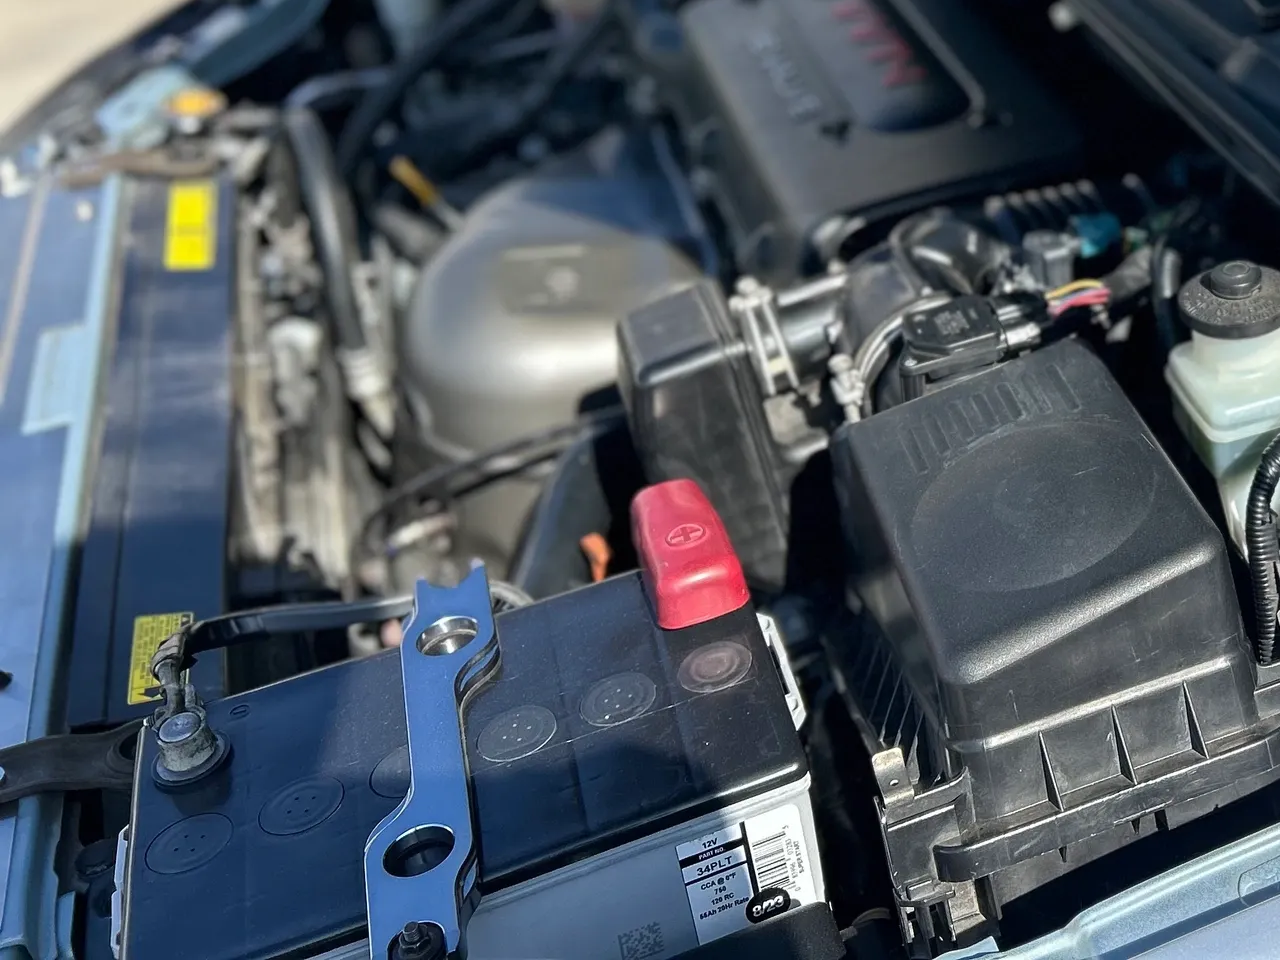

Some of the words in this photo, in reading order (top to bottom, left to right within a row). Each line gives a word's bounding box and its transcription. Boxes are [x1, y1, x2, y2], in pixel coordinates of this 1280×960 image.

[702, 837, 718, 849] 12V
[699, 850, 713, 860] PART
[696, 856, 732, 876] 34PLT
[700, 880, 717, 890] CCA
[724, 892, 735, 901] RC
[752, 895, 784, 917] 8/23
